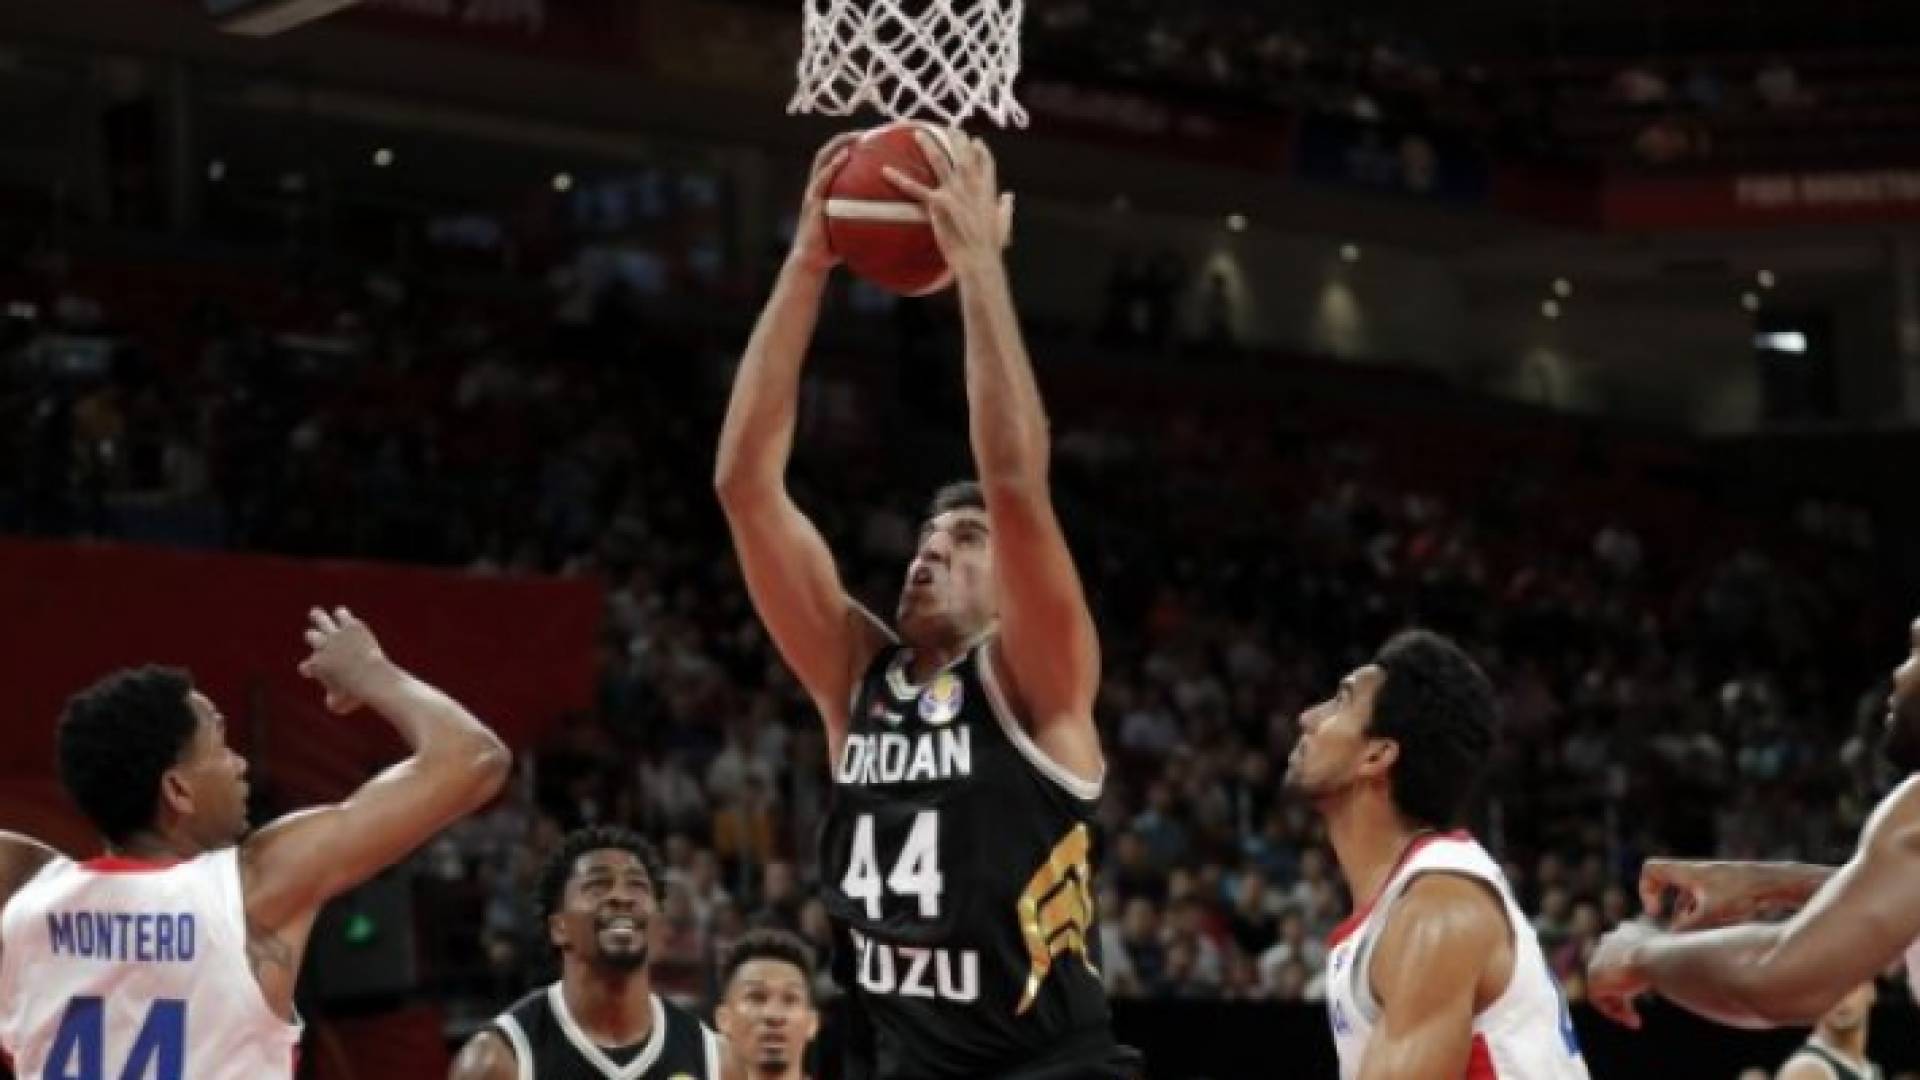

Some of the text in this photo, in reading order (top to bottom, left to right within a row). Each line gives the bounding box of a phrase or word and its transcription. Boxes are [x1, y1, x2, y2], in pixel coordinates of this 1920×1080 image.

[841, 810, 943, 920] 44
[47, 911, 196, 962] MONTERO
[850, 928, 980, 1002] UZU
[41, 995, 188, 1080] 44
